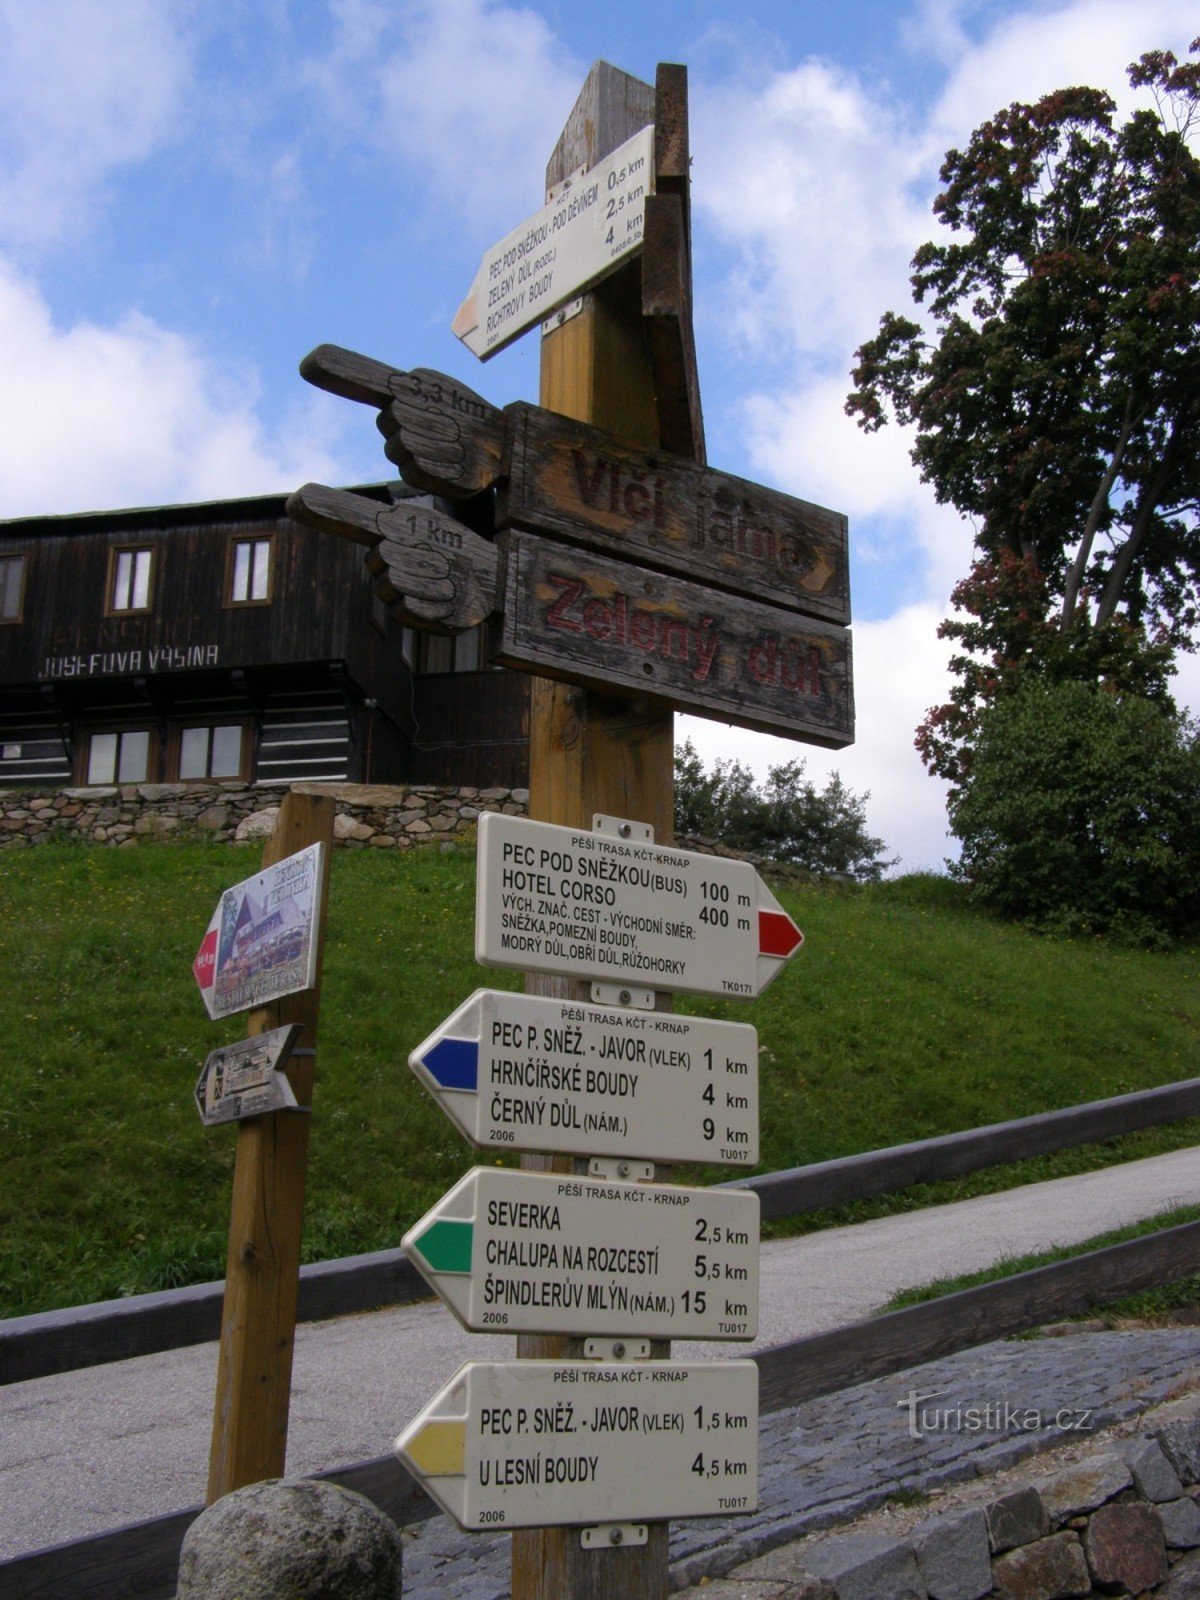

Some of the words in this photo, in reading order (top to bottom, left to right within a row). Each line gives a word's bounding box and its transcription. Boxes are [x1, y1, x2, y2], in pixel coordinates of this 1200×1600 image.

[489, 258, 502, 281] PEC
[502, 248, 516, 267] POD
[517, 222, 548, 260] SNĚŽKOU
[552, 209, 567, 234] POD
[607, 167, 626, 191] 0,5
[628, 157, 644, 176] km
[488, 269, 515, 308] ZELENÝ
[518, 258, 532, 285] DŮL
[606, 195, 624, 220] 2,5
[627, 185, 643, 204] km
[487, 291, 526, 334] RICHTROVY
[529, 271, 553, 303] BOUDY
[605, 225, 615, 246] 4
[626, 213, 642, 232] km
[452, 390, 485, 420] km
[571, 450, 666, 528] Vlčí
[407, 515, 416, 537] 1
[428, 520, 462, 549] km
[545, 574, 717, 680] Zelený
[751, 633, 820, 697] důl
[572, 837, 595, 850] PĚŠÍ
[598, 842, 631, 857] TRASA
[503, 843, 535, 866] PEC
[540, 850, 573, 873] POD
[700, 881, 729, 903] 100
[738, 894, 750, 906] m
[502, 892, 535, 913] VÝCH.
[538, 900, 570, 919] ZNAČ.
[574, 907, 600, 924] CEST
[610, 911, 663, 934] VÝCHODNÍ
[665, 921, 696, 940] SMĚR:
[503, 868, 556, 896] HOTEL
[560, 879, 616, 906] CORSO
[699, 906, 729, 927] 400
[738, 918, 750, 930] m
[501, 933, 541, 953] MODRÝ
[600, 929, 638, 950] BOUDY,
[561, 1008, 585, 1021] PĚŠÍ
[588, 1012, 623, 1026] TRASA
[655, 1022, 690, 1035] KRNAP
[492, 1021, 522, 1048] PEC
[528, 1026, 539, 1051] P.
[544, 1025, 586, 1056] SNĚŽ.
[599, 1035, 646, 1063] JAVOR
[649, 1048, 691, 1072] (VLEK)
[704, 1048, 713, 1071] 1
[726, 1058, 748, 1075] km
[491, 1057, 582, 1092] HRNČÍŘSKÉ
[586, 1070, 639, 1098] BOUDY
[702, 1083, 715, 1106] 4
[726, 1092, 748, 1109] km
[491, 1091, 546, 1125] ČERNÝ
[550, 1098, 581, 1129] DŮL
[583, 1111, 628, 1137] (NÁM.)
[703, 1118, 715, 1141] 9
[726, 1127, 748, 1144] km
[489, 1129, 515, 1142] 2006
[720, 1149, 748, 1160] TU017
[558, 1183, 582, 1197] PĚŠÍ
[585, 1187, 622, 1200] TRASA
[624, 1190, 645, 1202] KČT
[654, 1194, 690, 1206] KRNAP
[487, 1200, 561, 1230] SEVERKA
[694, 1218, 721, 1245] 2,5
[726, 1228, 749, 1245] km
[486, 1239, 558, 1269] CHALUPA
[563, 1245, 583, 1271] NA
[587, 1246, 659, 1275] ROZCESTÍ
[694, 1254, 720, 1281] 5,5
[725, 1264, 748, 1281] km
[484, 1272, 584, 1308] ŠPINDLERŮV
[587, 1280, 628, 1310] MLÝN
[630, 1292, 675, 1317] (NÁM.)
[681, 1290, 706, 1314] 15
[725, 1299, 748, 1316] km
[483, 1312, 508, 1324] 2006
[718, 1322, 747, 1334] TU017
[554, 1370, 579, 1383] PĚŠÍ
[582, 1372, 618, 1383] TRASA
[621, 1370, 643, 1382] KČT
[652, 1371, 689, 1382] KRNAP
[481, 1408, 512, 1435] PEC
[517, 1408, 529, 1434] P.
[534, 1401, 577, 1434] SNĚŽ.
[591, 1406, 639, 1432] JAVOR
[642, 1413, 685, 1435] (VLEK)
[693, 1405, 720, 1432] 1,5
[725, 1413, 748, 1429] km
[479, 1460, 490, 1486] U
[495, 1452, 541, 1486] LESNÍ
[545, 1456, 599, 1484] BOUDY
[691, 1452, 720, 1479] 4,5
[724, 1459, 747, 1475] km
[479, 1511, 505, 1523] 2006
[718, 1497, 748, 1508] TU017
